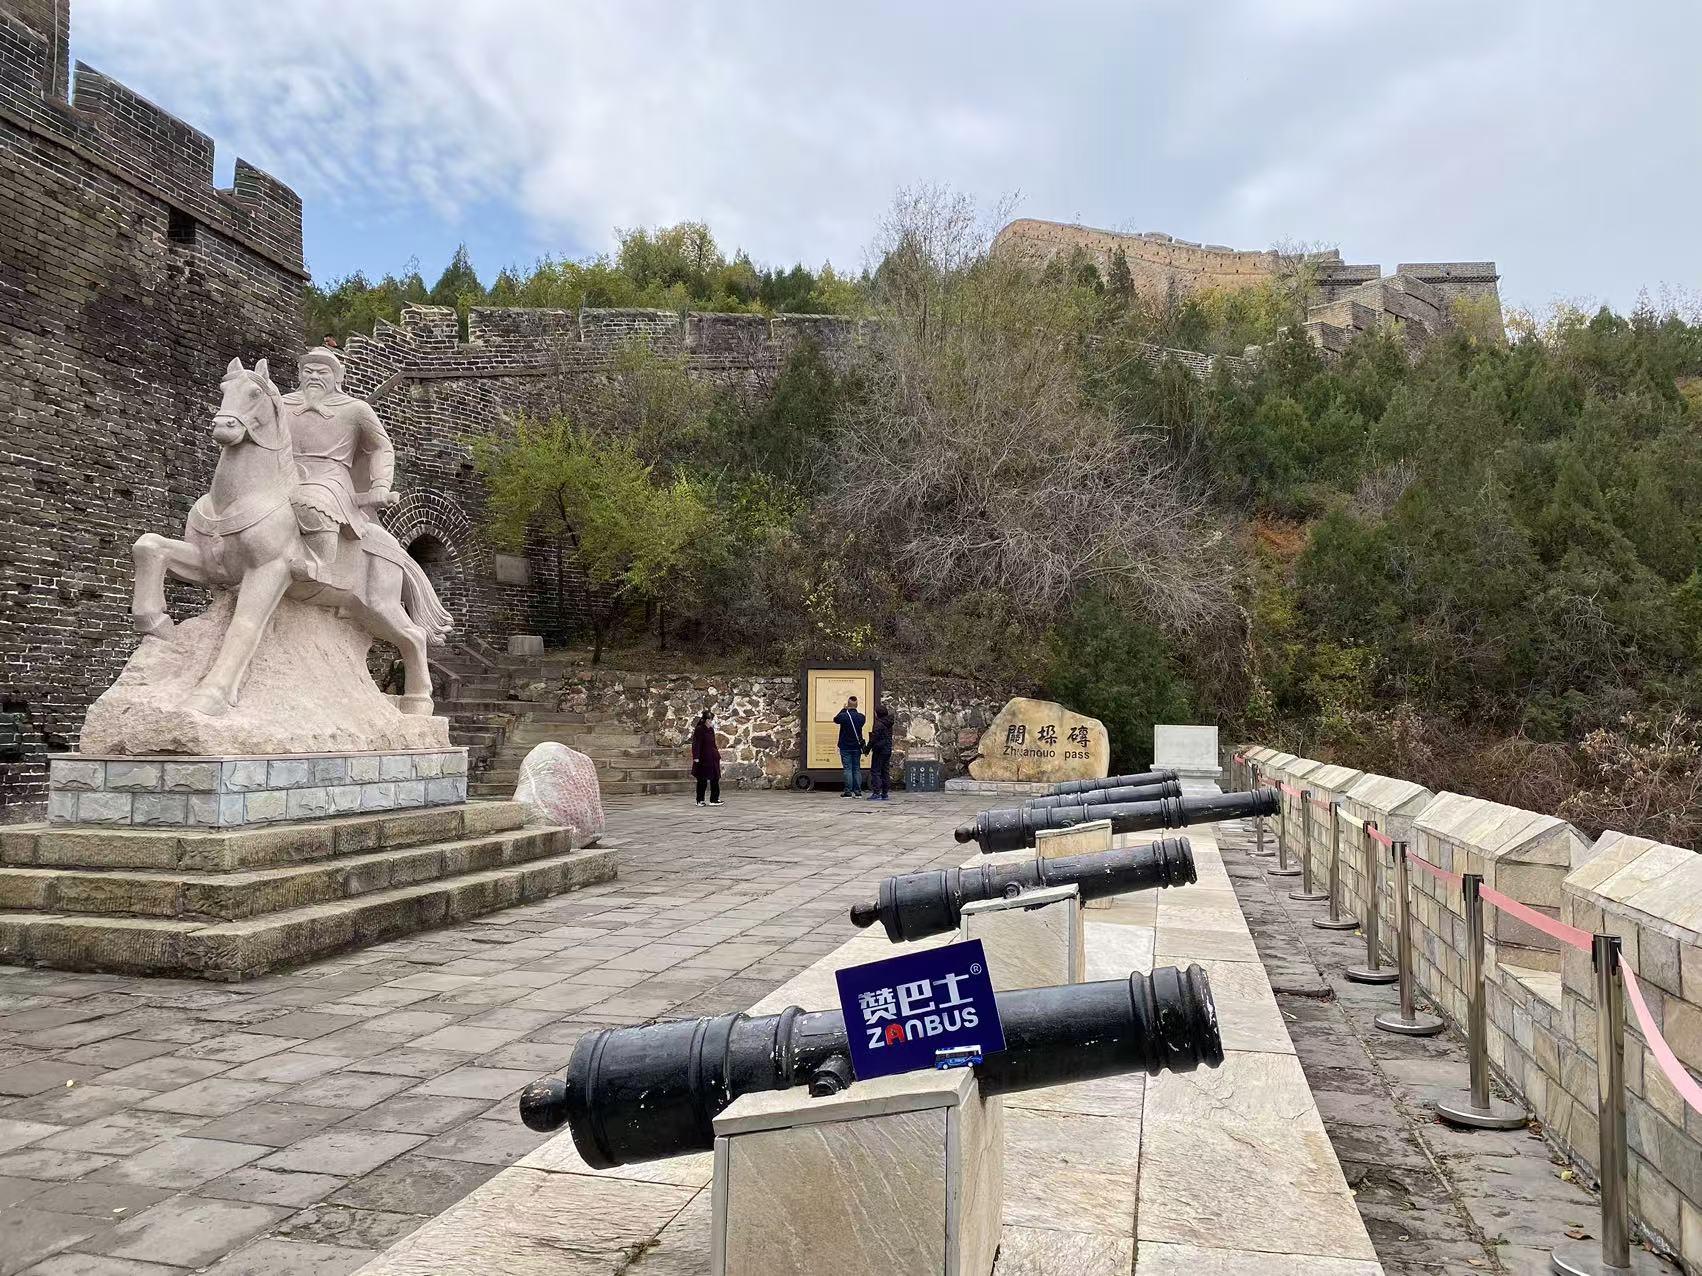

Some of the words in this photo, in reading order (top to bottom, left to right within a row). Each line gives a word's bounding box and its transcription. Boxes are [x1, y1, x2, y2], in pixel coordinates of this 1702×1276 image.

[1064, 750, 1090, 760] pass
[858, 973, 974, 1025] 赞巴士
[866, 1007, 979, 1049] ZANBUS
